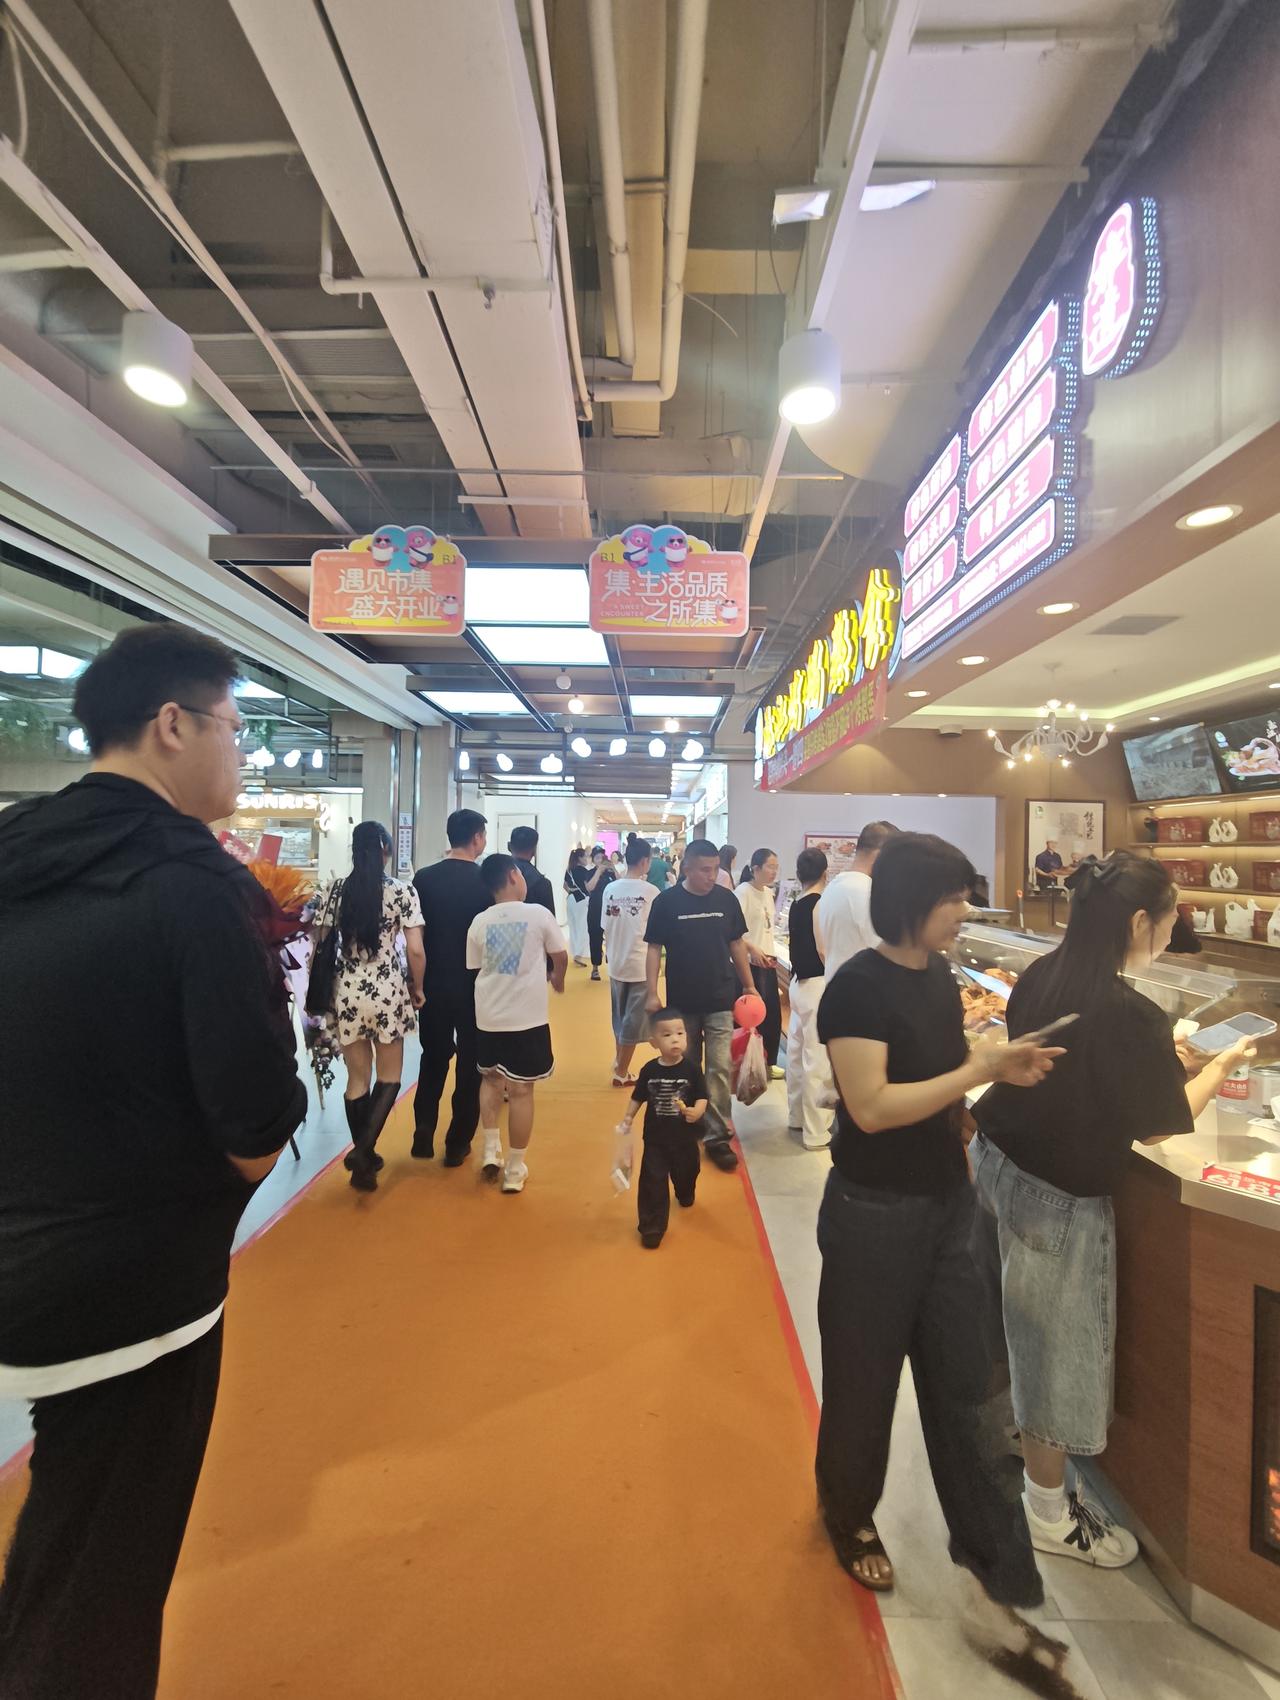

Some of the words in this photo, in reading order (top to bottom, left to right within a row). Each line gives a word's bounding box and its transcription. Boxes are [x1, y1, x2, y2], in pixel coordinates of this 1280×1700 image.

[443, 554, 457, 565] B1
[600, 552, 616, 563] B1
[334, 568, 437, 595] 遇见市集
[346, 595, 442, 624] 盛大开业
[641, 596, 718, 627] 之所集
